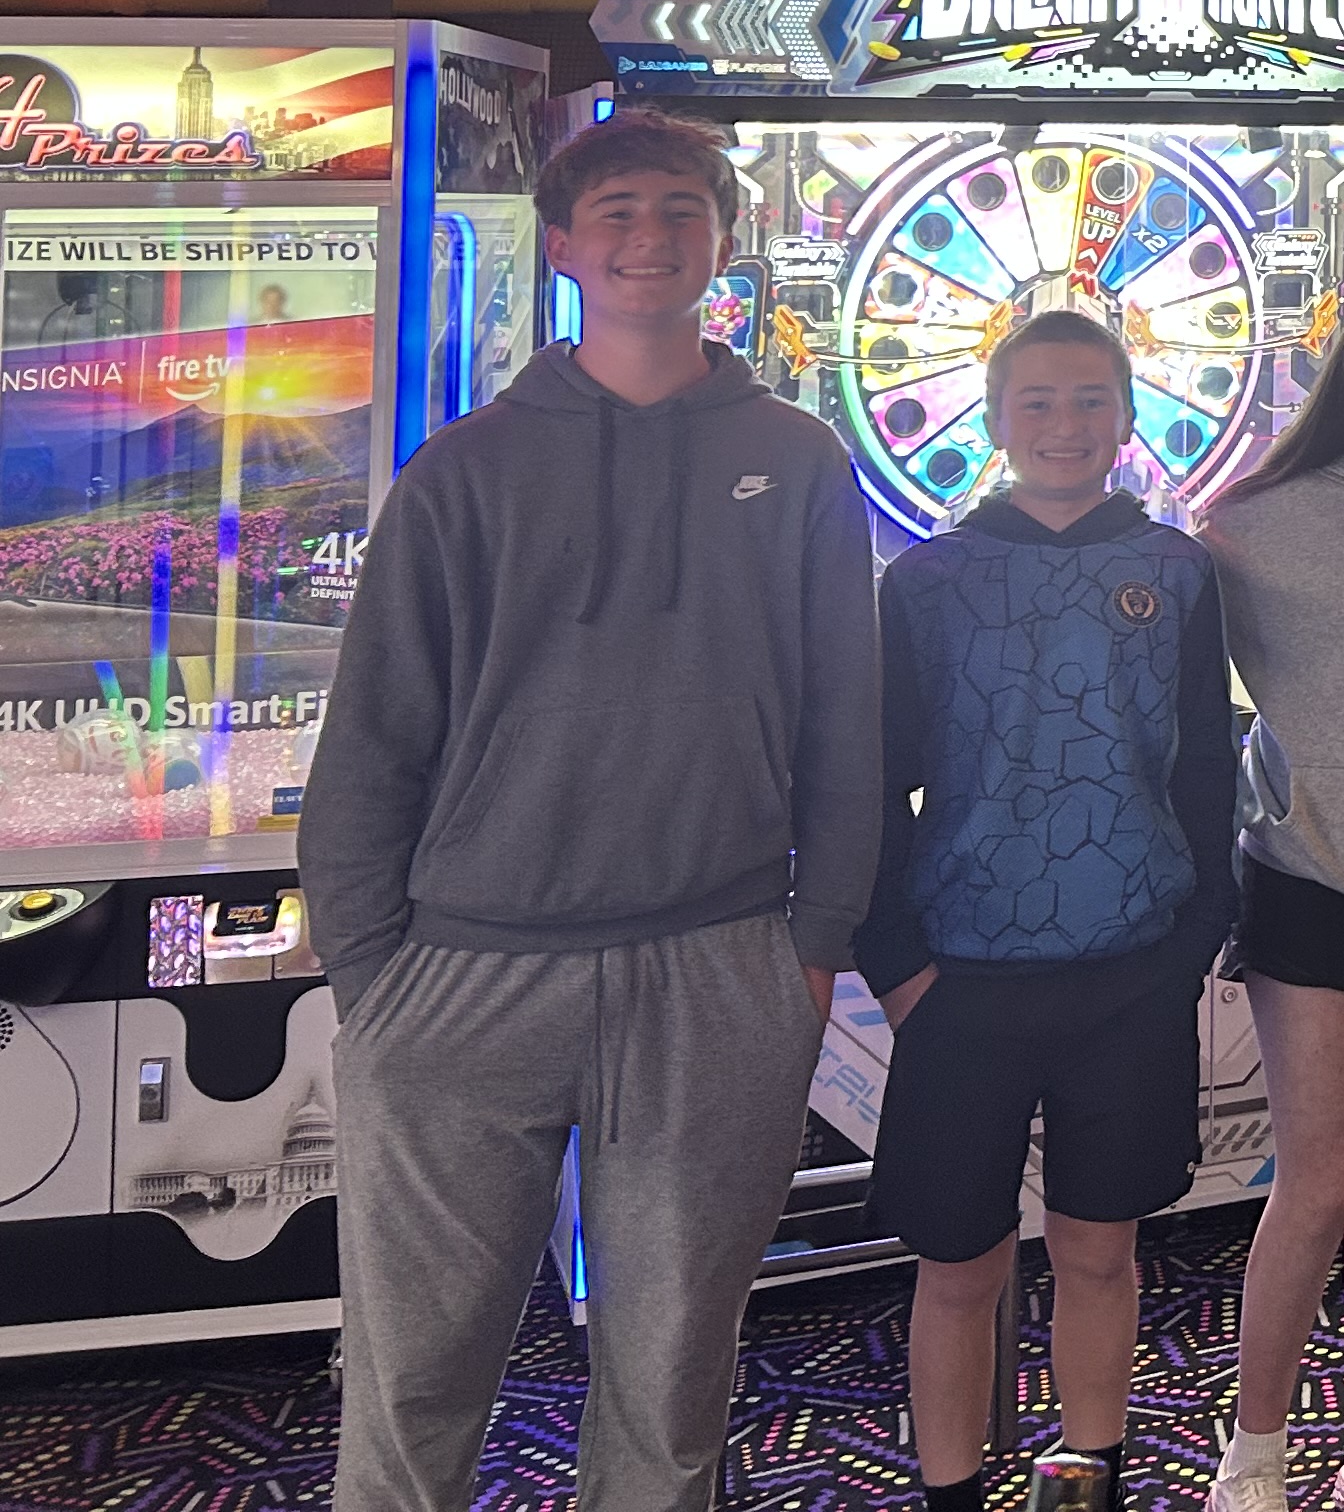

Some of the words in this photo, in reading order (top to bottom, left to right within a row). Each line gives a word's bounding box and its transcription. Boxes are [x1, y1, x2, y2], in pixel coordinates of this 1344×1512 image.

[22, 121, 258, 168] Prizes
[1085, 203, 1122, 224] LEVEL
[1082, 217, 1117, 244] UP
[60, 240, 132, 262] WILL
[140, 240, 178, 262] BE
[185, 241, 314, 261] SHIPPED
[321, 241, 360, 262] TO
[157, 354, 200, 382] fire
[312, 530, 370, 576] 4K
[164, 693, 283, 728] Smart
